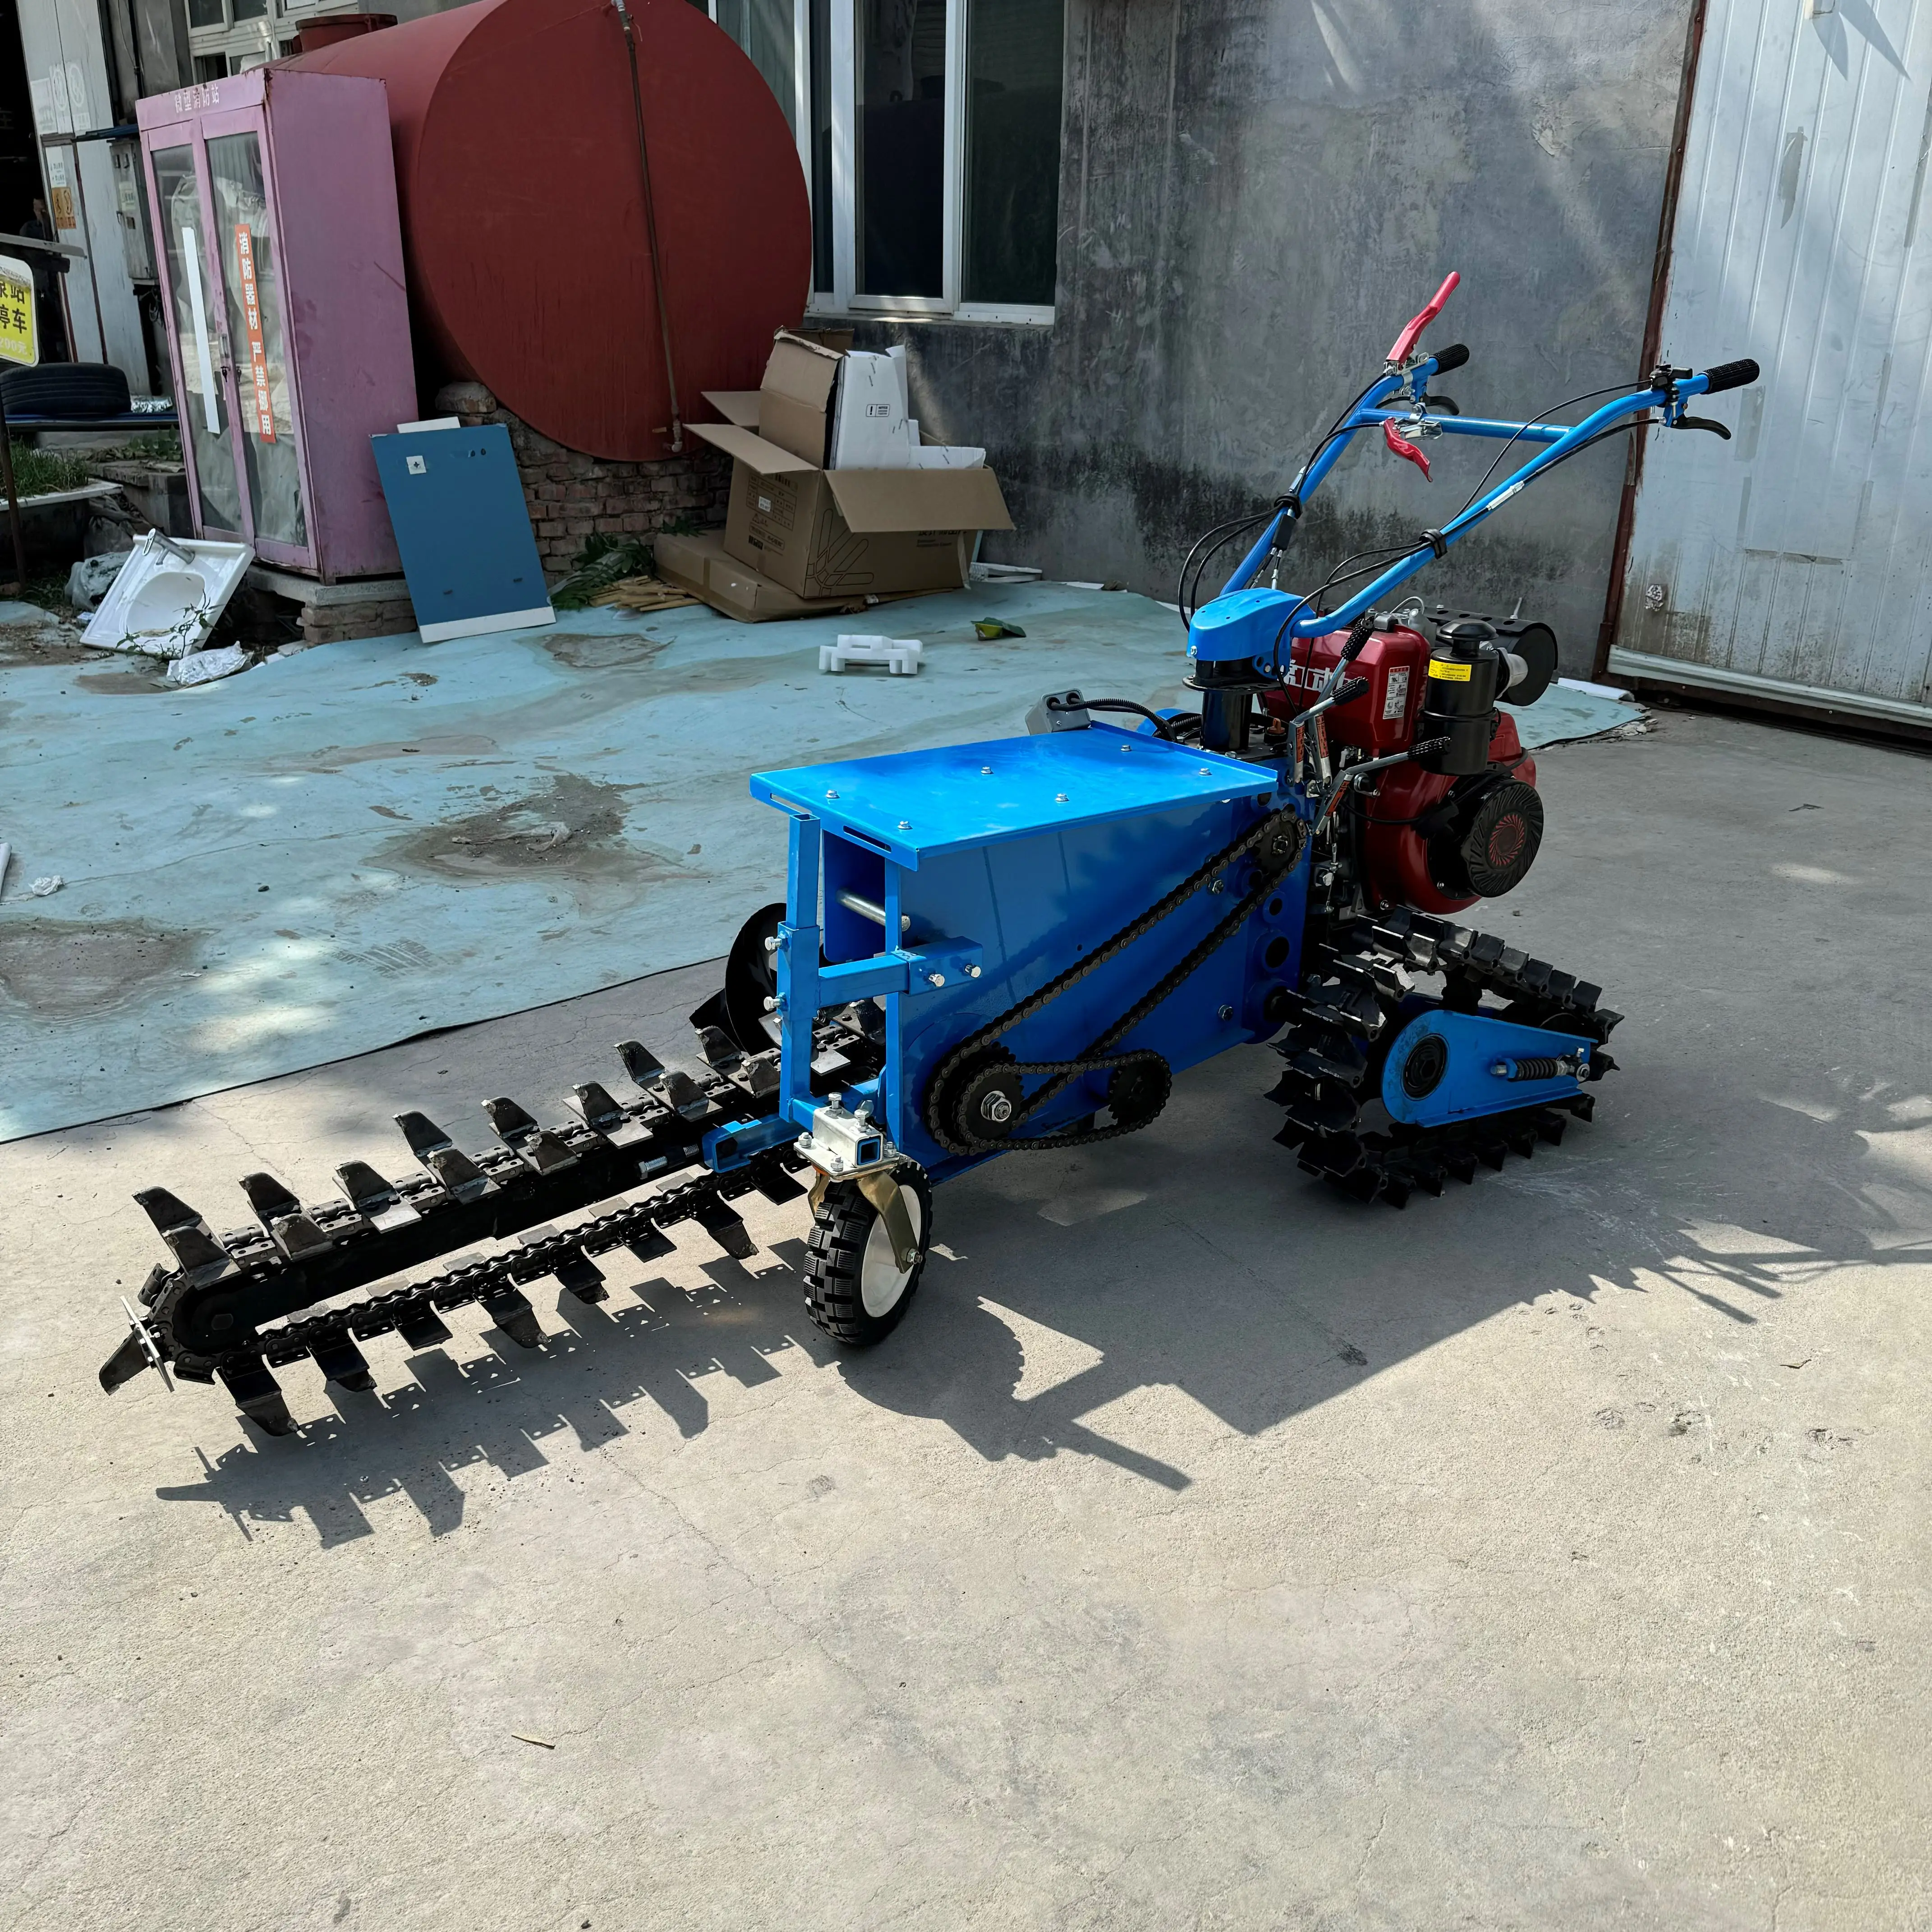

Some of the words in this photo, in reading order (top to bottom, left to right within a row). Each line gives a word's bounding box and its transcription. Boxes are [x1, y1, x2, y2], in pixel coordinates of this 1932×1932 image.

[175, 83, 219, 113] 微型消防站
[239, 231, 258, 330] 消防器材
[252, 341, 271, 435] 严禁挪用
